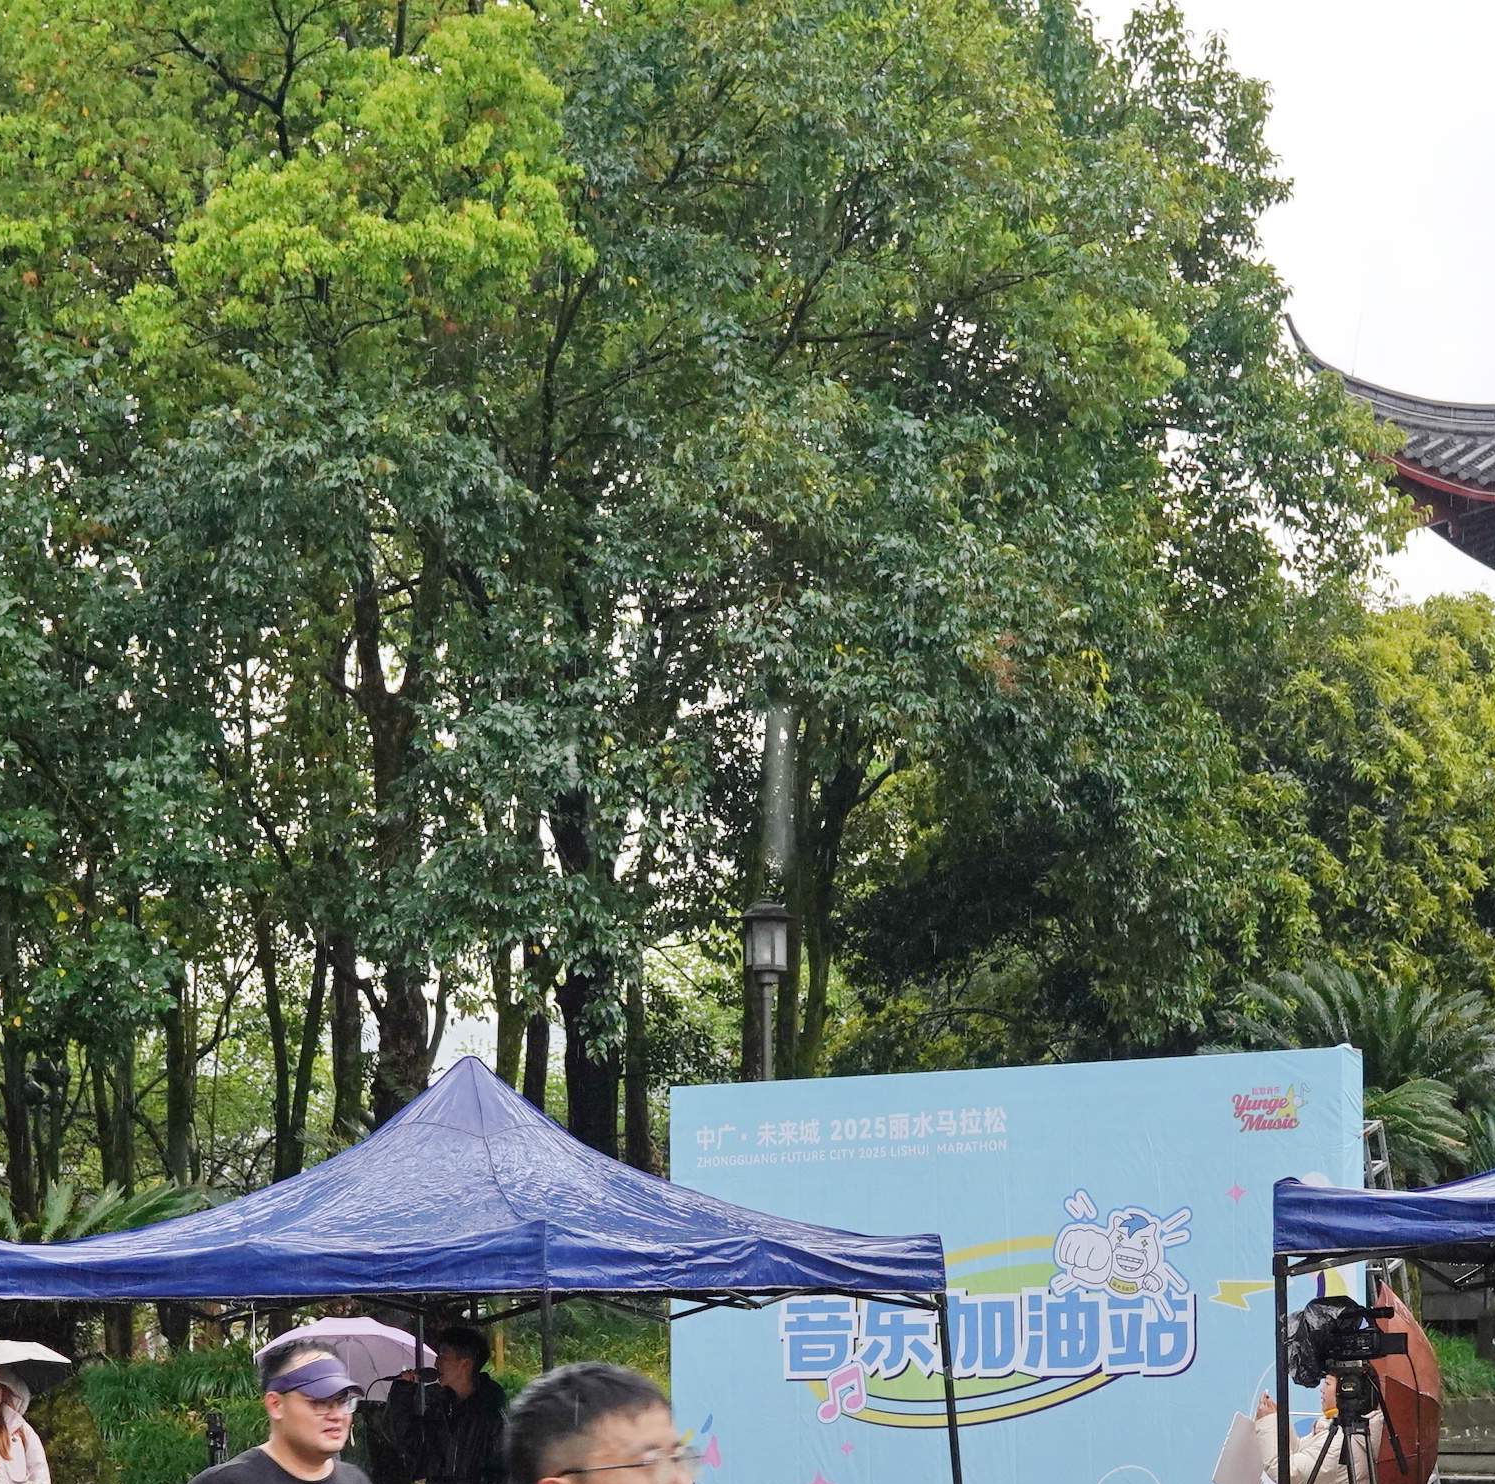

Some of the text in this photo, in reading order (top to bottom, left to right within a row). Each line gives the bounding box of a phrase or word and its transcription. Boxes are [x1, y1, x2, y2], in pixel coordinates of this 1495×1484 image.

[1232, 1094, 1290, 1118] Yunge
[829, 1105, 1007, 1142] 2025丽水马拉松
[1239, 1113, 1300, 1133] Music
[697, 1139, 1007, 1168] ZHONGGUANG FUTURE CITY 2025 LISHUI MARATHON
[781, 1289, 1195, 1378] 音乐加油站
